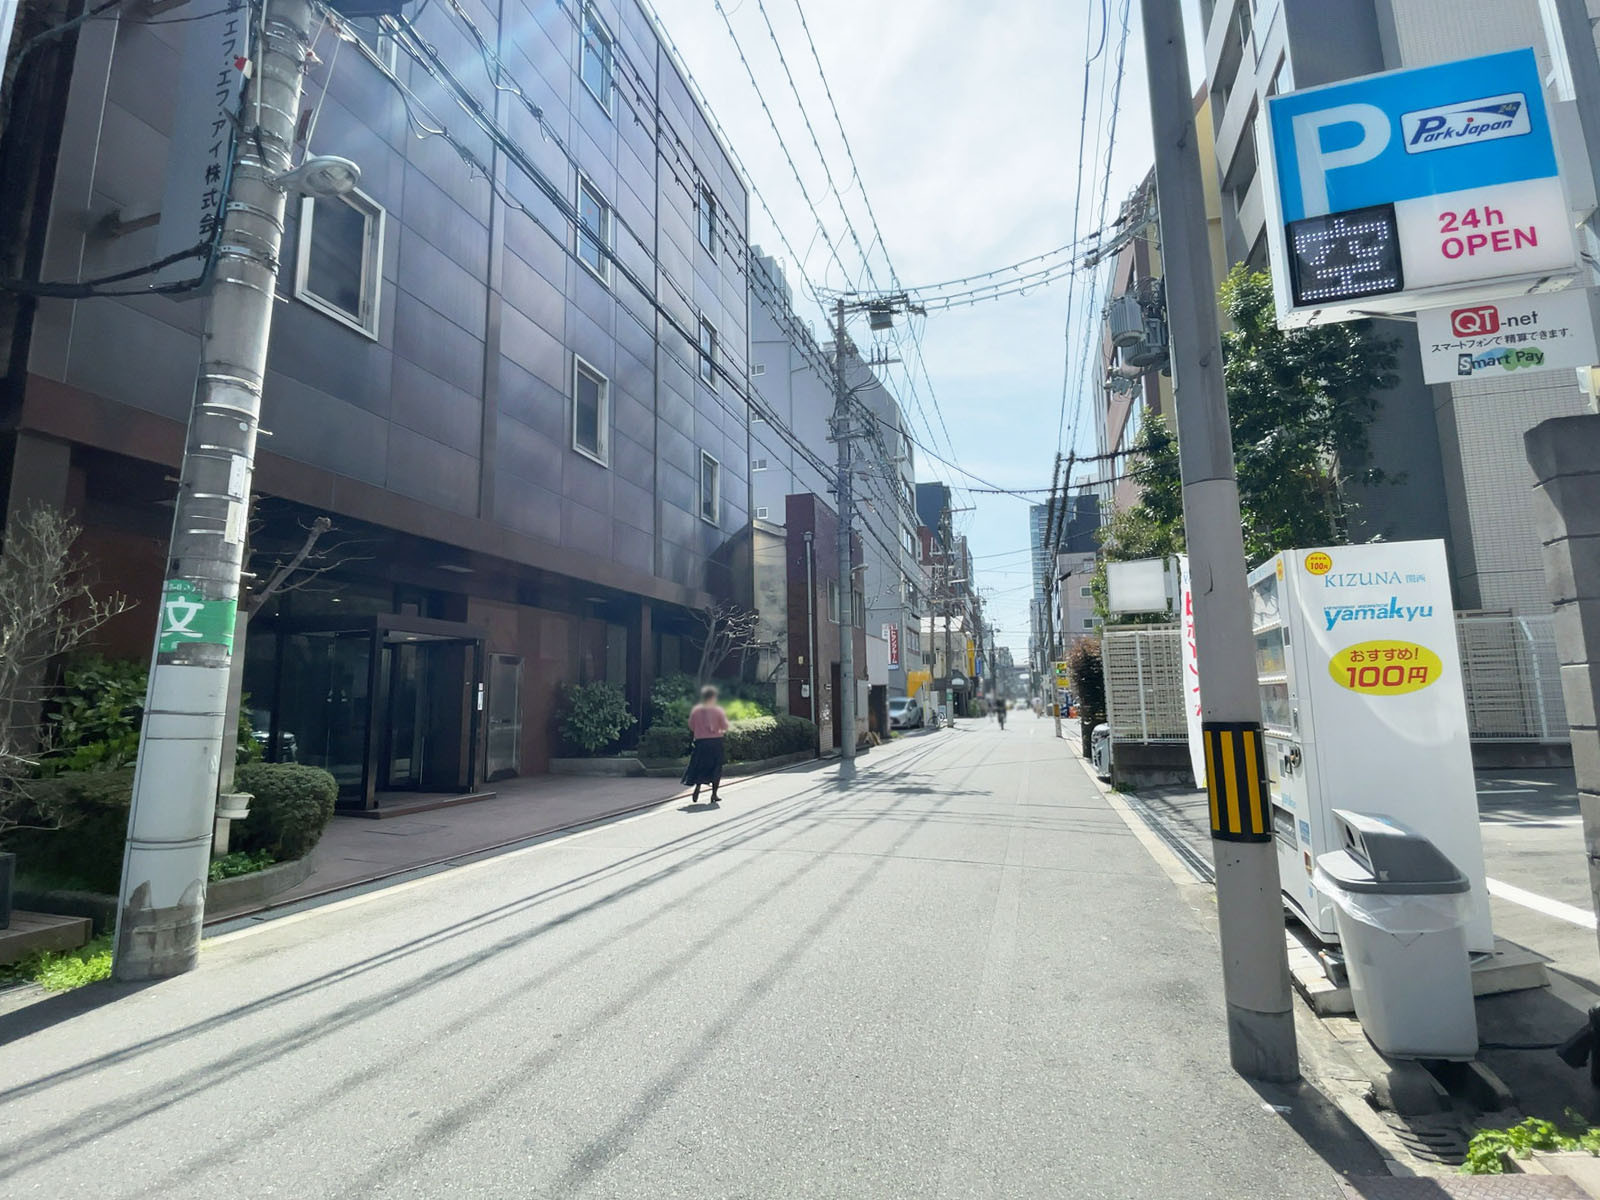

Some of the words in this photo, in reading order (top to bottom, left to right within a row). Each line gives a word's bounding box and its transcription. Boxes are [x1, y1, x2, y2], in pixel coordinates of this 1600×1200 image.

[1409, 115, 1456, 146] Park
[1455, 117, 1513, 137] Japan
[1292, 103, 1392, 218] P
[1439, 206, 1504, 234] 24h
[1441, 226, 1538, 259] OPEN
[1294, 218, 1396, 300] 空
[1458, 353, 1512, 372] Smart
[1515, 350, 1545, 365] Pay
[1325, 571, 1402, 588] KIZUNA
[161, 596, 204, 638] 文
[1323, 596, 1433, 631] yamakyu
[1346, 665, 1428, 688] 100円
